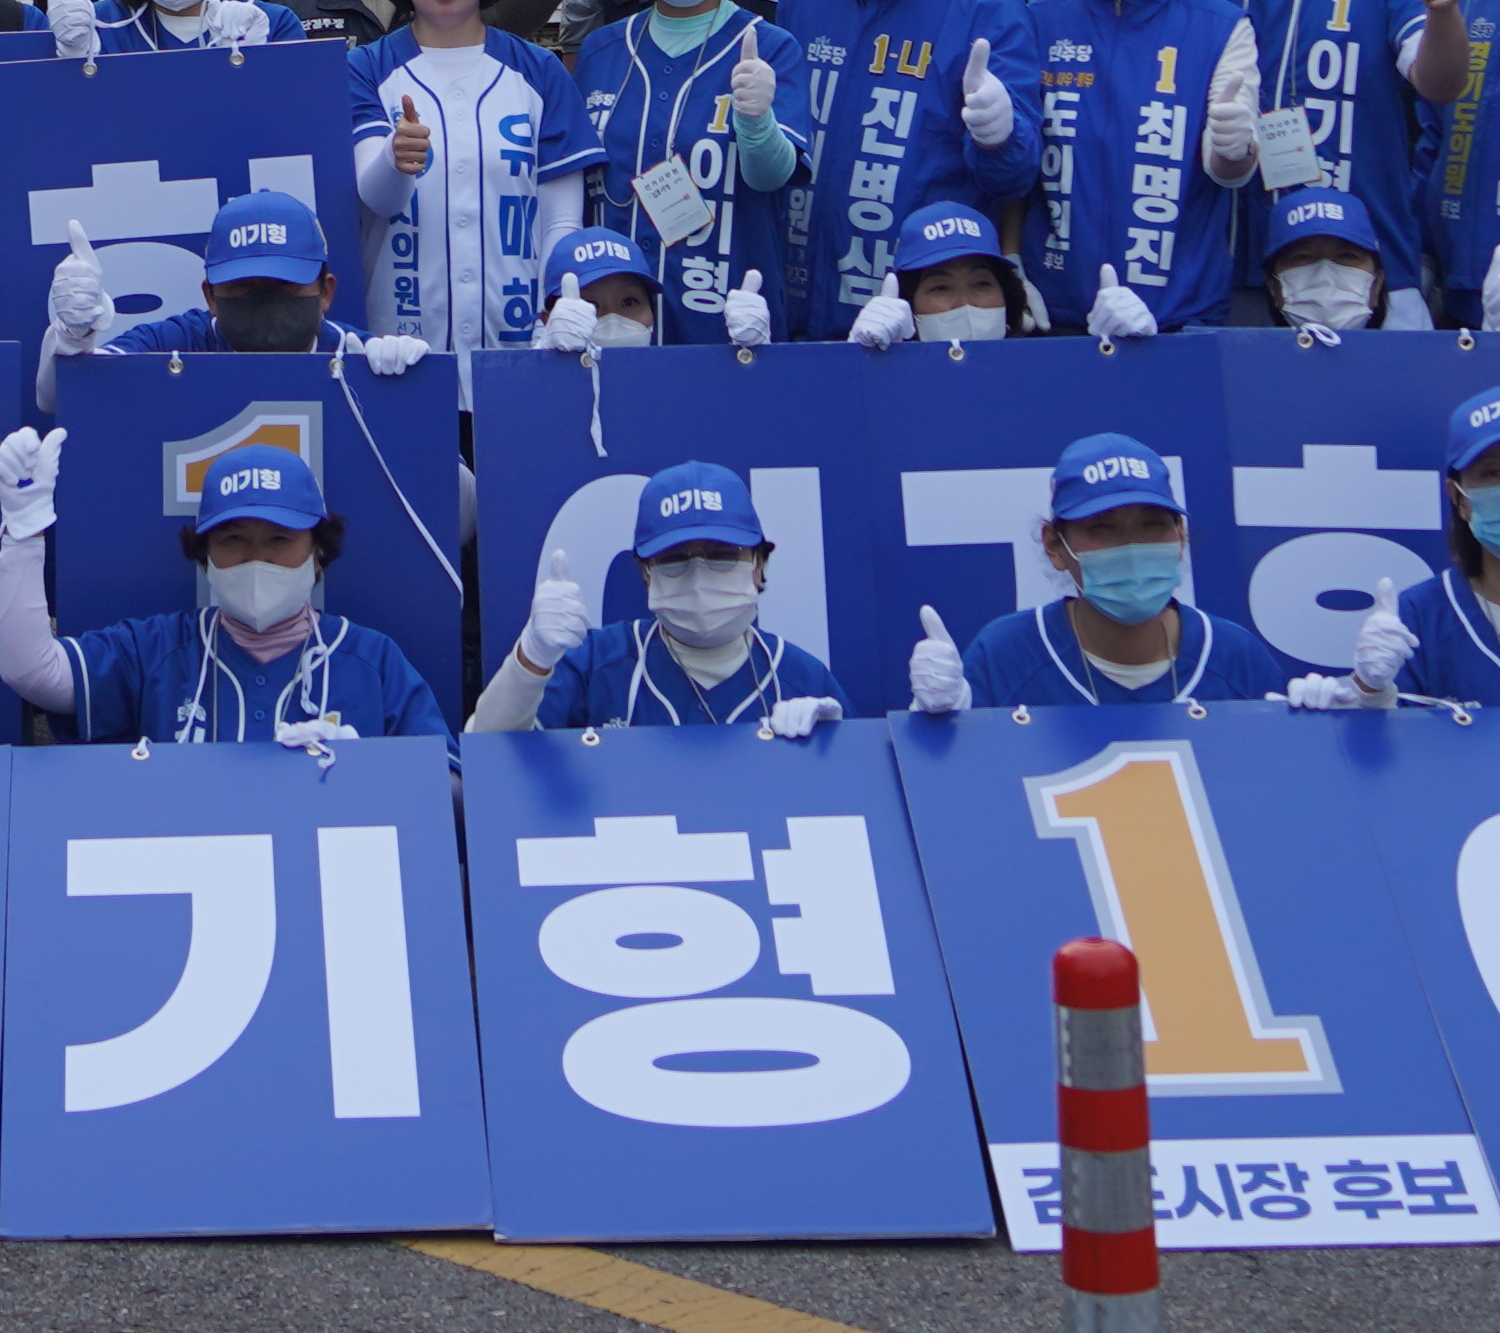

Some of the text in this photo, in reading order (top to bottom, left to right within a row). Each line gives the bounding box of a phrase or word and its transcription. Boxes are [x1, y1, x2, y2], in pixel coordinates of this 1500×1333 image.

[868, 33, 933, 80] 1-나
[1155, 45, 1178, 96] 1
[706, 93, 733, 134] 1
[1040, 90, 1081, 252] 도의원
[837, 85, 919, 308] 진병삼
[1124, 99, 1190, 289] 최명진
[1286, 201, 1345, 227] 이기형
[228, 222, 289, 250] 이기형
[922, 216, 983, 243] 이기형
[572, 238, 632, 265] 이기형
[218, 466, 283, 497] 이기형
[1083, 455, 1151, 486] 이기형
[659, 487, 723, 518] 이기형
[1023, 738, 1346, 1098] 1
[1325, 1158, 1478, 1220] 후보
